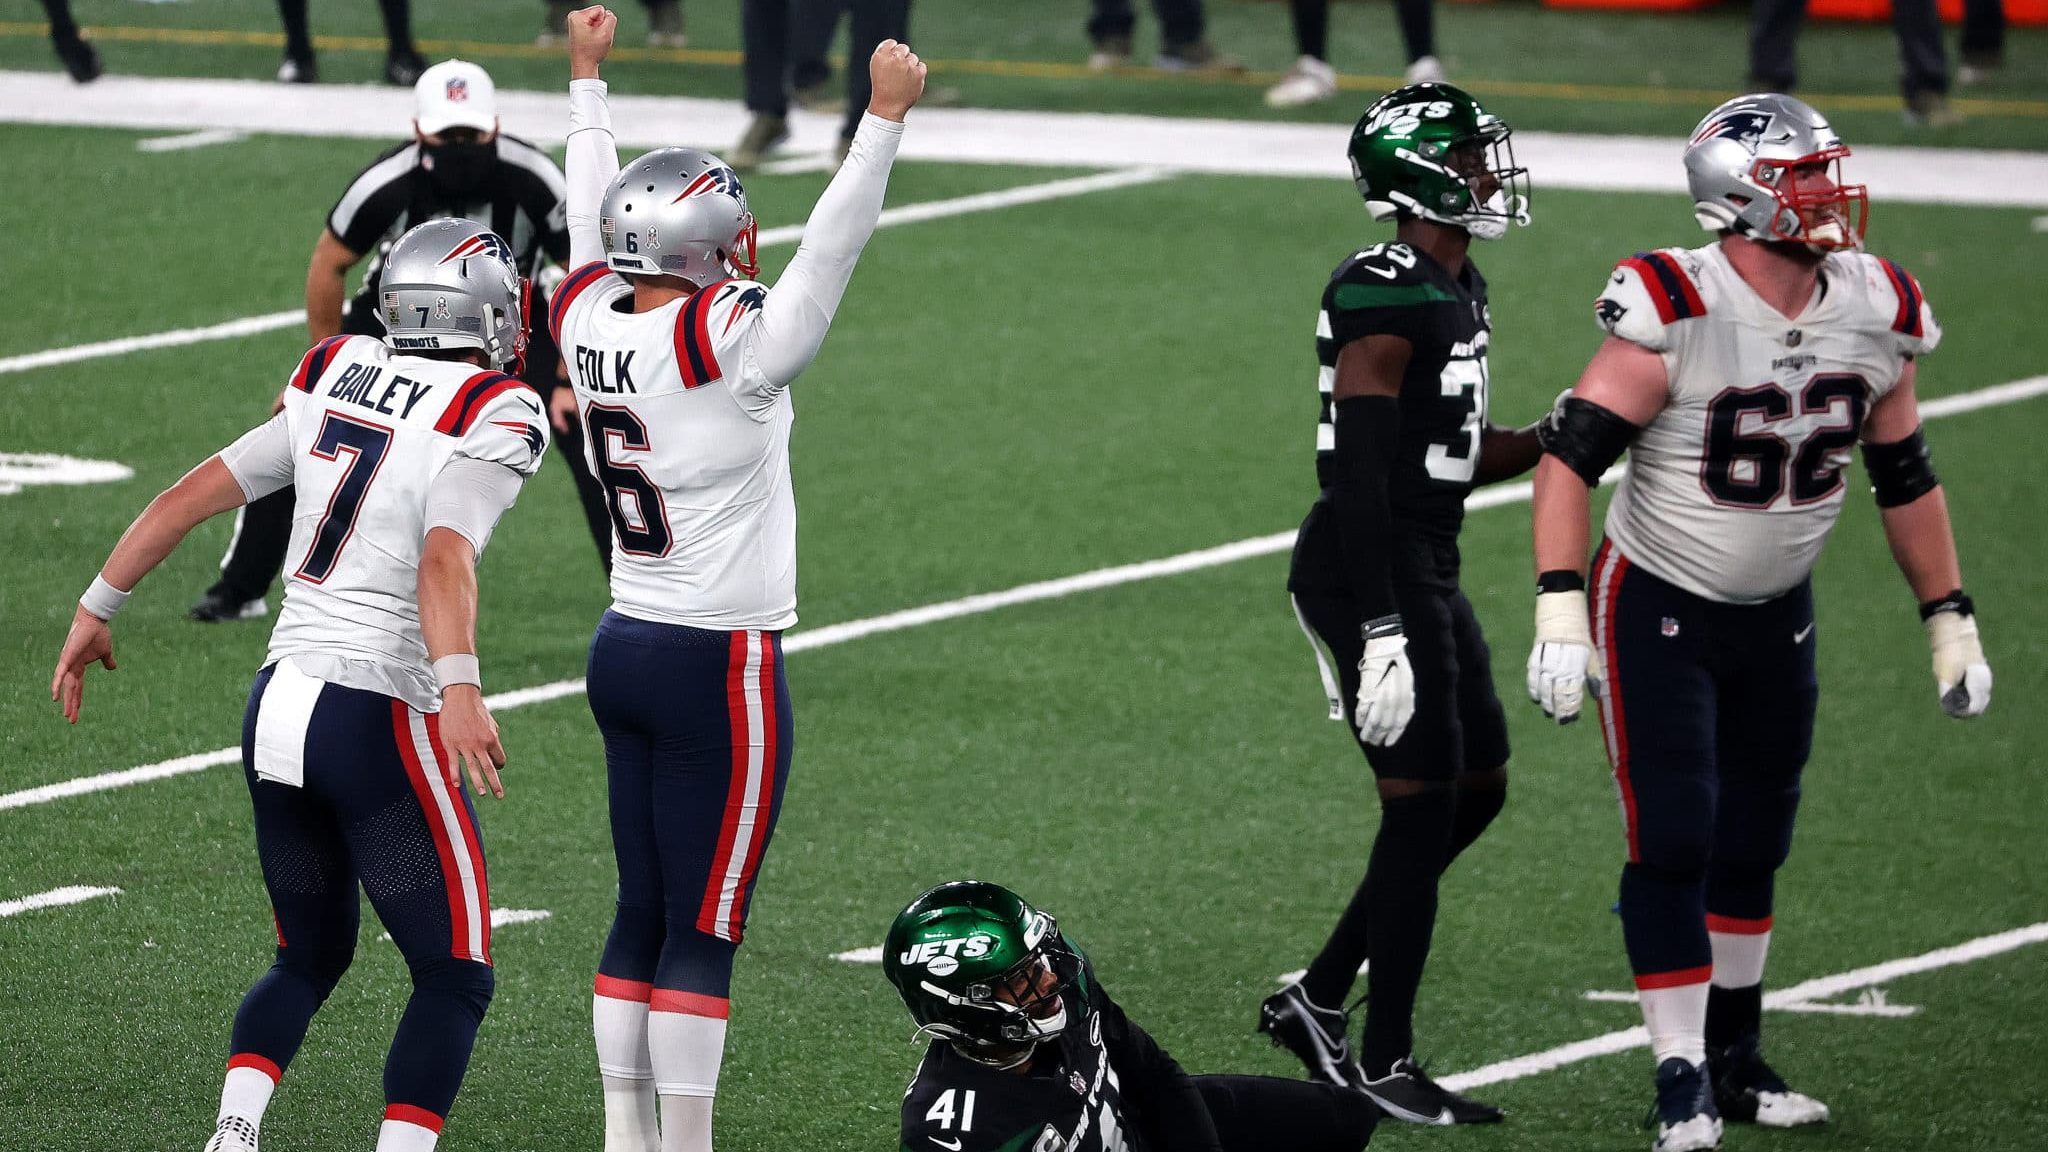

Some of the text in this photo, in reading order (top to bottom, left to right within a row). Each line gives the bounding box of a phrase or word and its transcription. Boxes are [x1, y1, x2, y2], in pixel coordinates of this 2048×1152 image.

[1364, 101, 1453, 135] JETS
[625, 232, 638, 254] 6
[415, 306, 430, 328] 7
[392, 336, 440, 349] PATRIOTS
[327, 362, 433, 420] BAILEY
[576, 344, 637, 393] FOLK
[1425, 356, 1489, 483] 3
[1700, 371, 1871, 510] 62
[293, 408, 394, 586] 7
[584, 400, 674, 558] 6
[900, 935, 991, 965] JETS
[925, 1088, 976, 1132] 41
